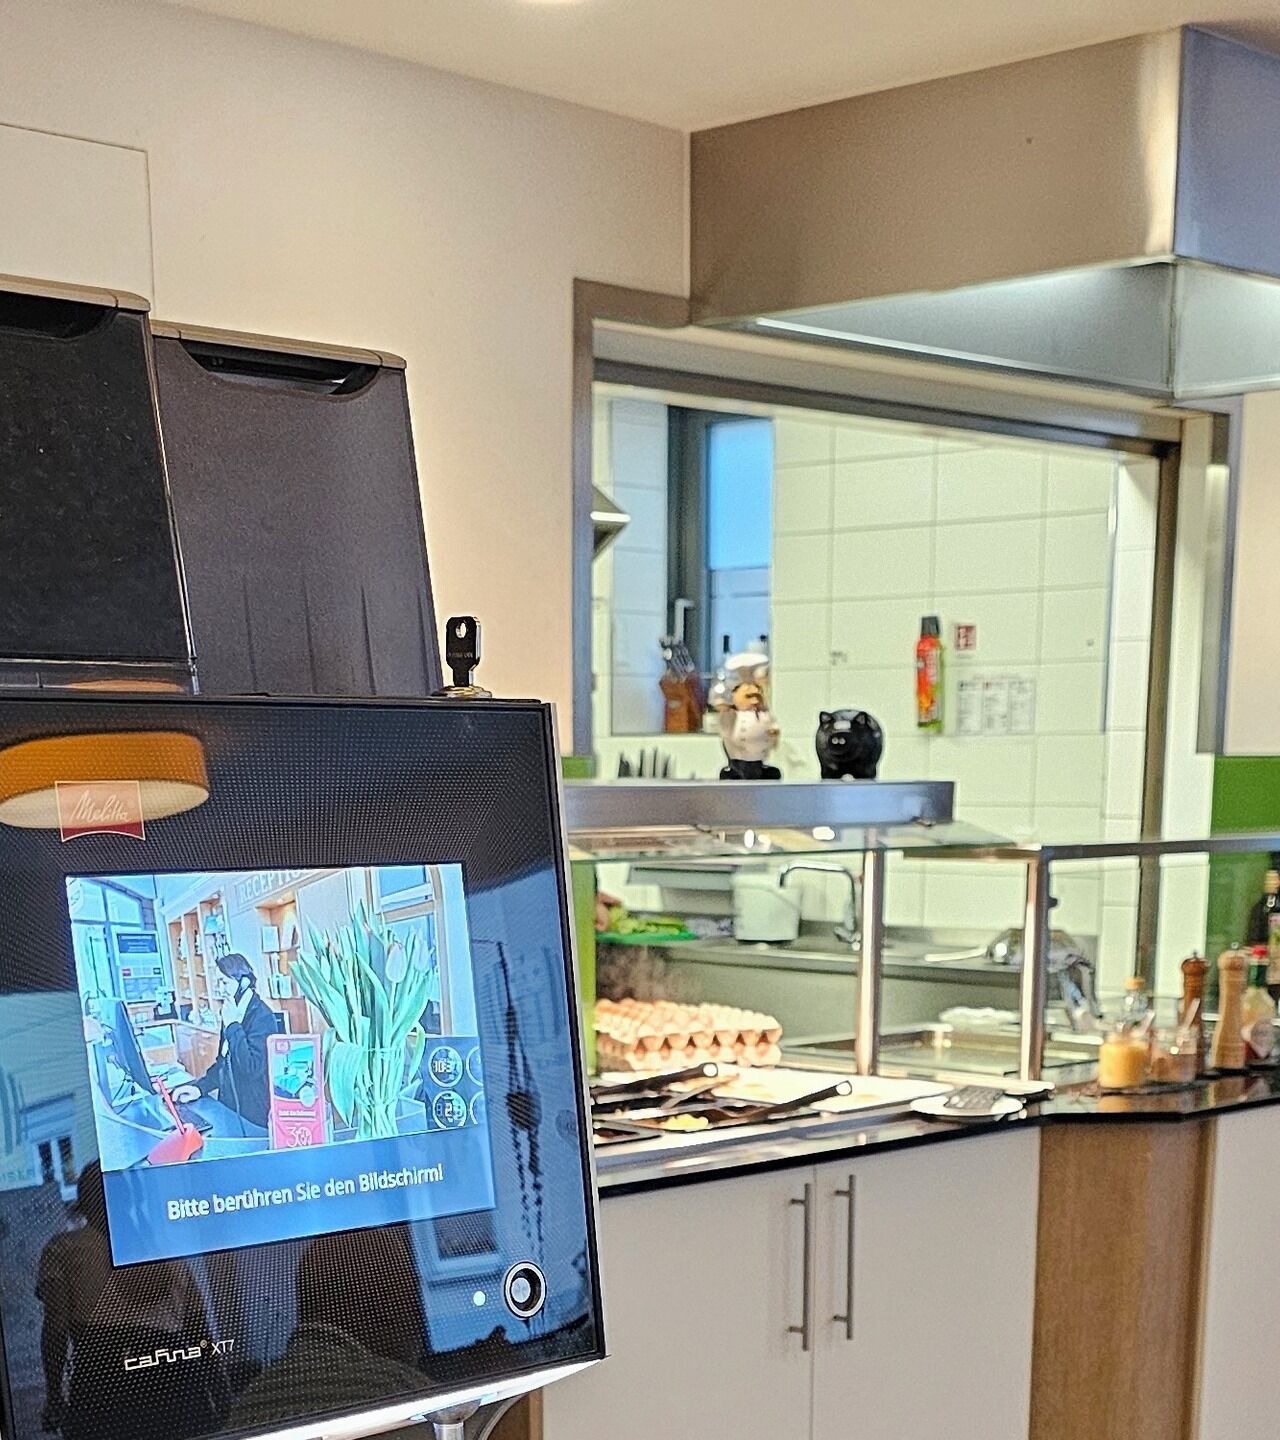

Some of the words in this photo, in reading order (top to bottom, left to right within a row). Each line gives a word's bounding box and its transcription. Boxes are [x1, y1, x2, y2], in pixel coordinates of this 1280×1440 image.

[69, 789, 132, 824] Melitta
[167, 1199, 210, 1221] Bitte
[213, 1187, 293, 1214] berühren
[296, 1182, 321, 1203] Sie
[325, 1177, 355, 1197] den
[211, 1339, 235, 1356] XT7
